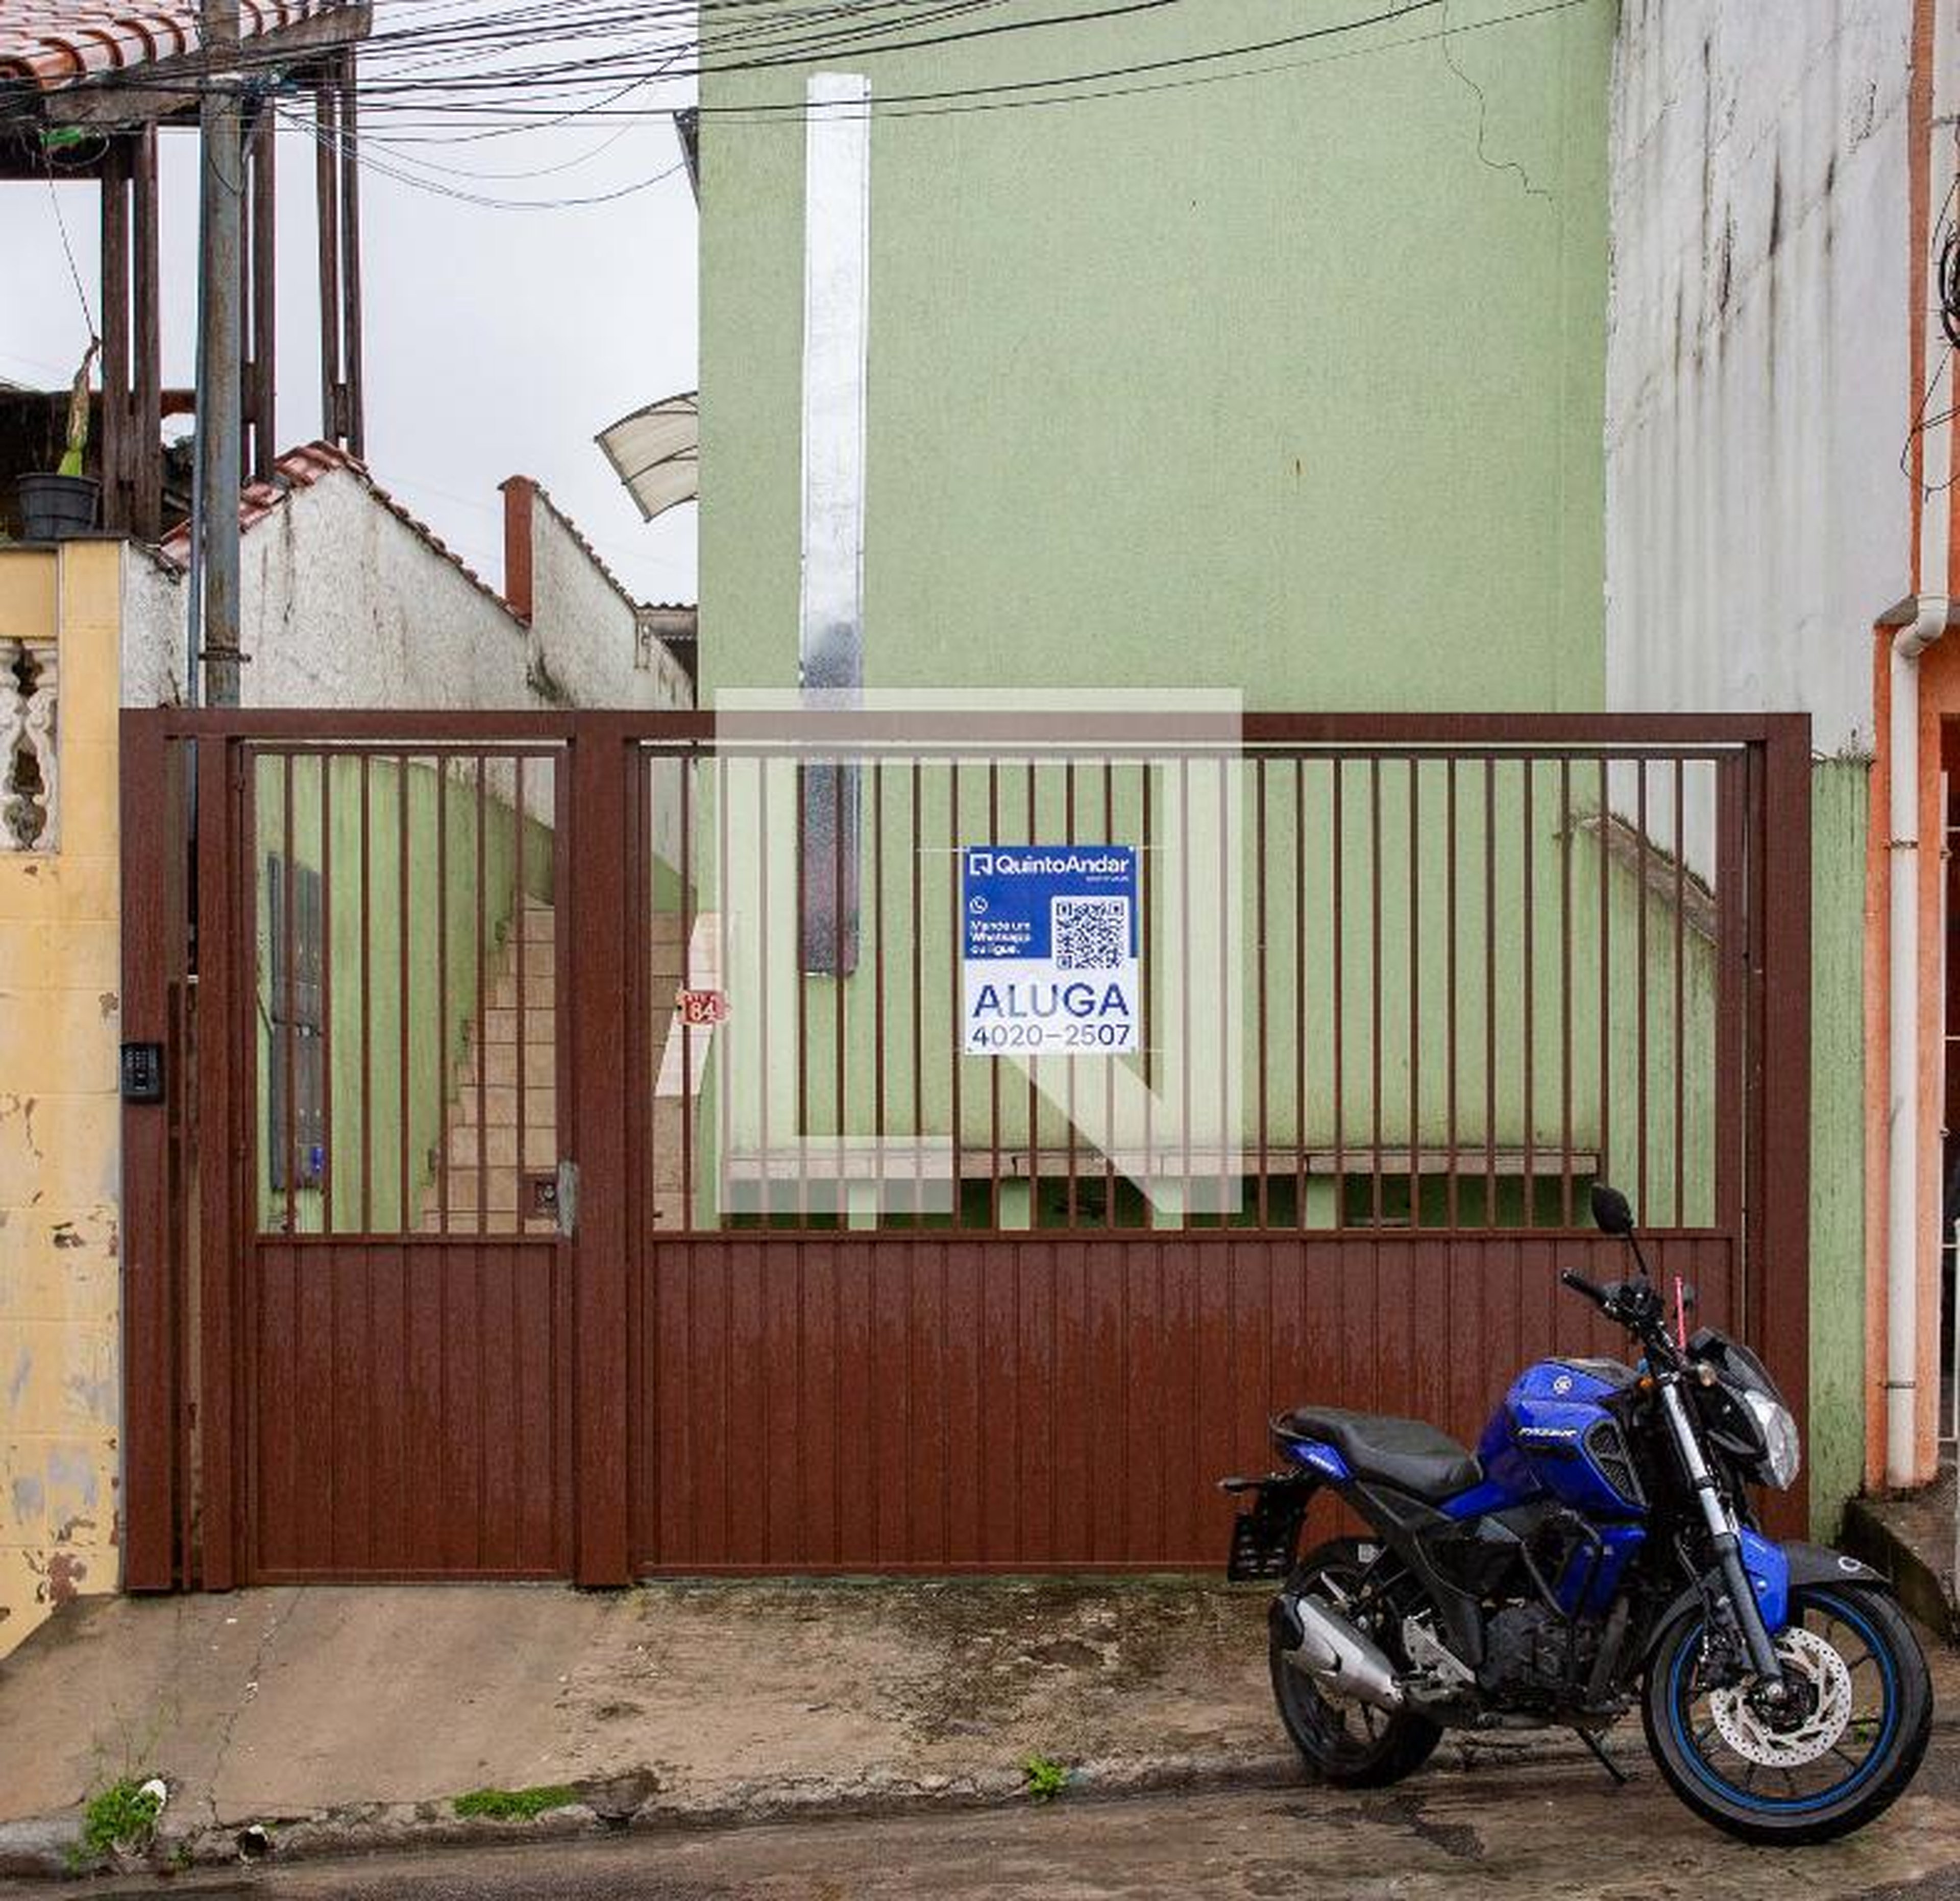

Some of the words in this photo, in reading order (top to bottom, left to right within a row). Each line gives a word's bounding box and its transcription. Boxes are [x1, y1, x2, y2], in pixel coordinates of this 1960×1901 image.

[996, 856, 1130, 874] QuintoAndar
[972, 983, 1129, 1018] ALUGA
[972, 1024, 1131, 1046] 4020-2507
